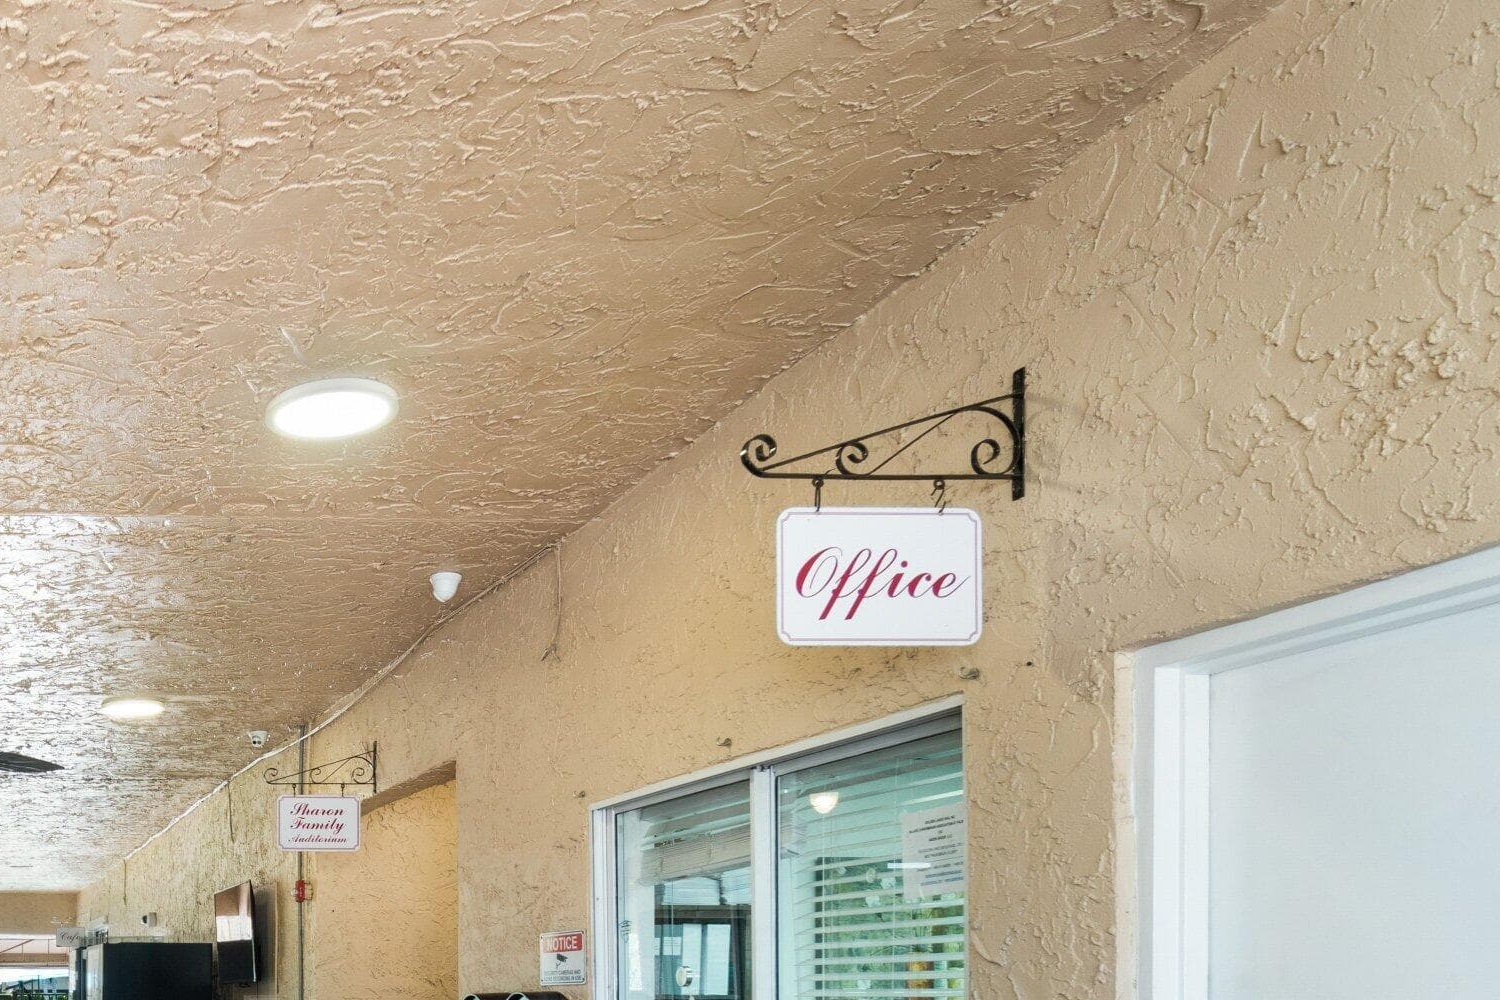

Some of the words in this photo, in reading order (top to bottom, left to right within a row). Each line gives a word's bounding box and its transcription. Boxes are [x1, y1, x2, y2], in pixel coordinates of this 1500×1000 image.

[795, 546, 972, 621] Office
[289, 802, 344, 816] Sharon
[289, 816, 345, 835] Family
[288, 834, 347, 844] Auditorium
[546, 936, 578, 952] NOTICE
